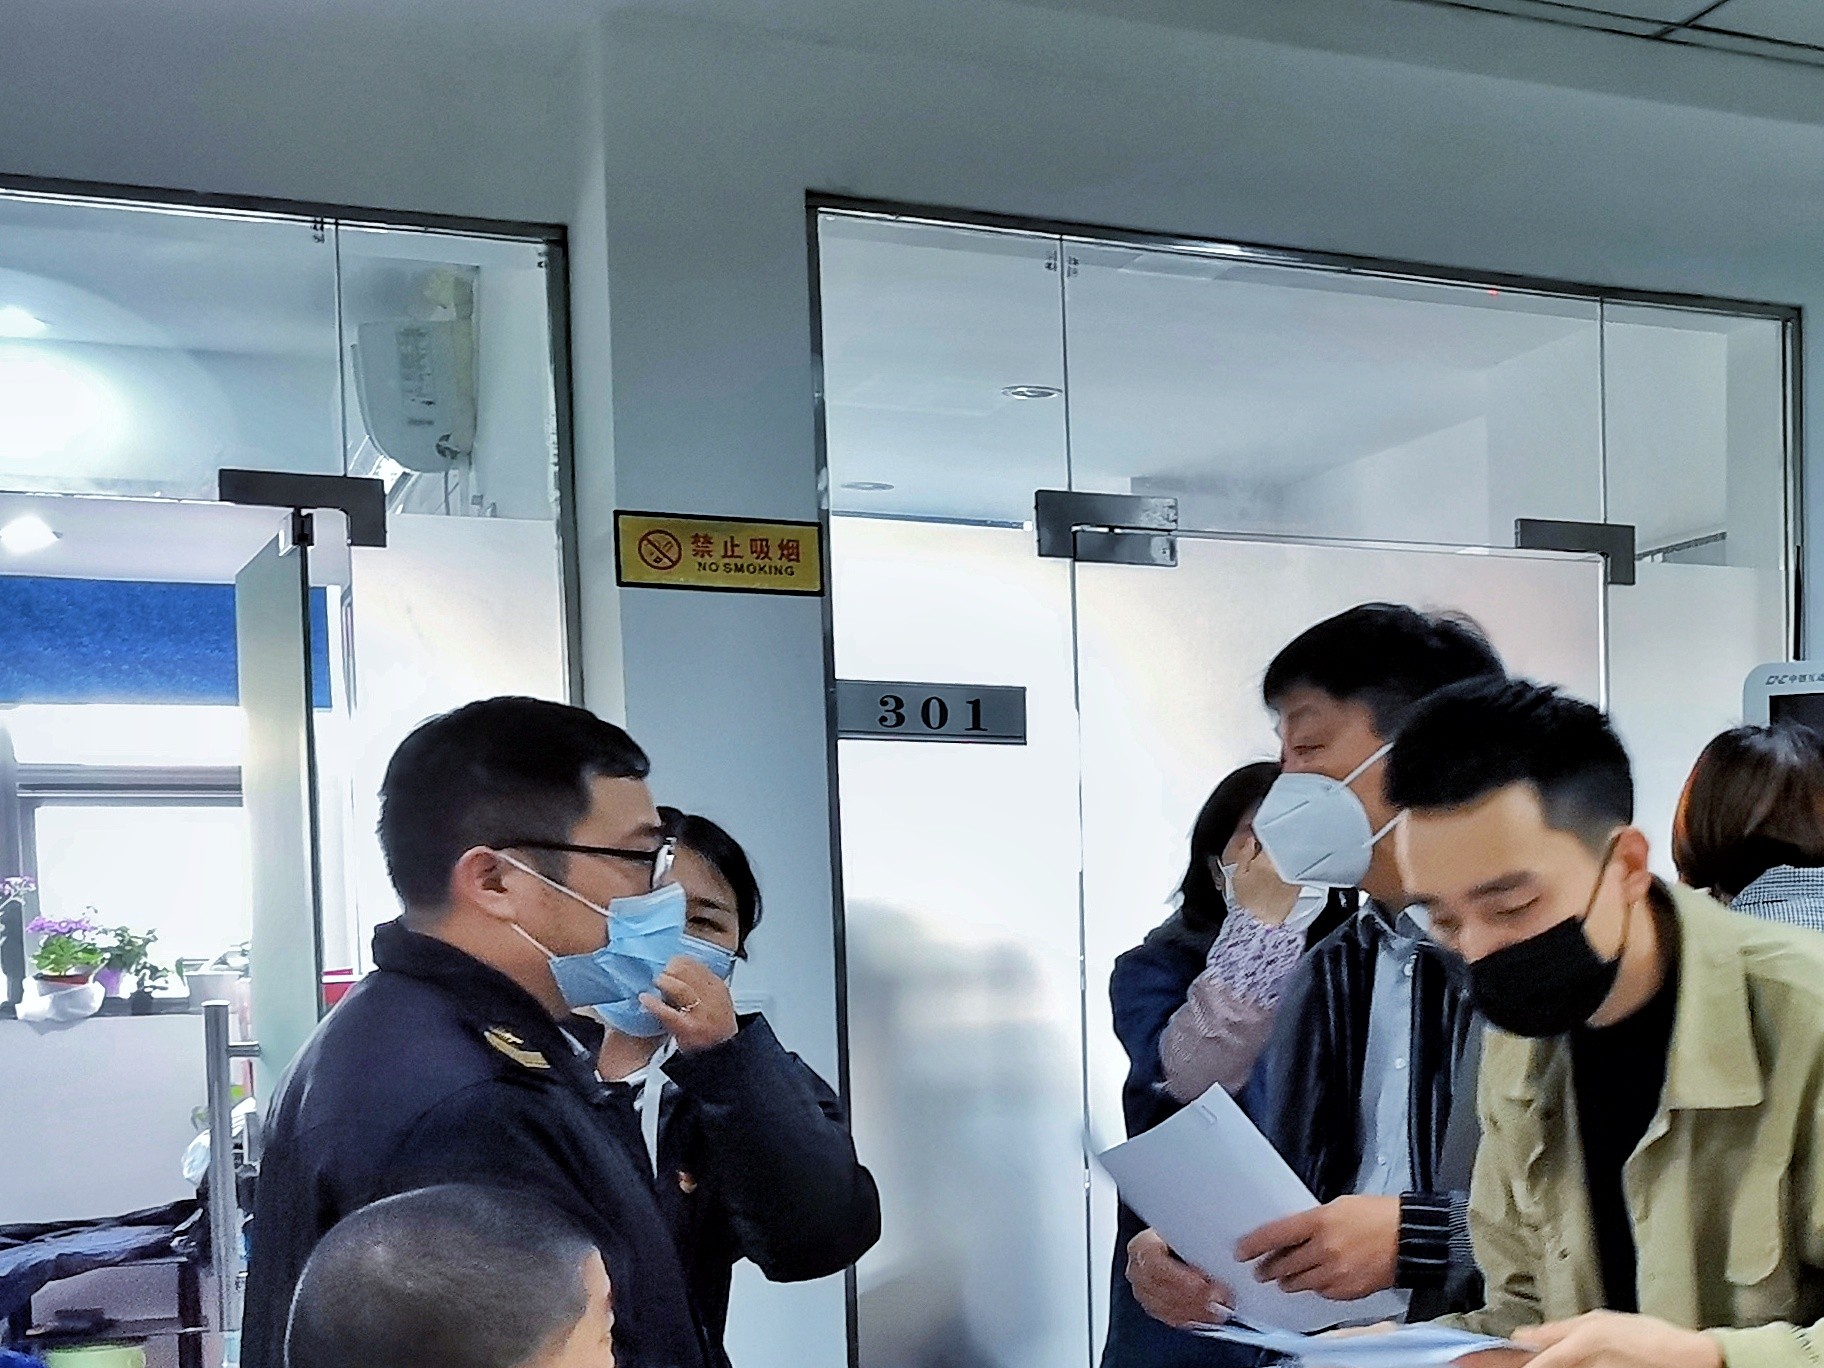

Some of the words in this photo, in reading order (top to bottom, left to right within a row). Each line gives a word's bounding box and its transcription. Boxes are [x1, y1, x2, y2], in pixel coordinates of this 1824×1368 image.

[691, 532, 801, 563] 禁止吸烟
[697, 561, 719, 573] NO
[723, 562, 795, 576] SMOKING
[878, 693, 989, 732] 301
